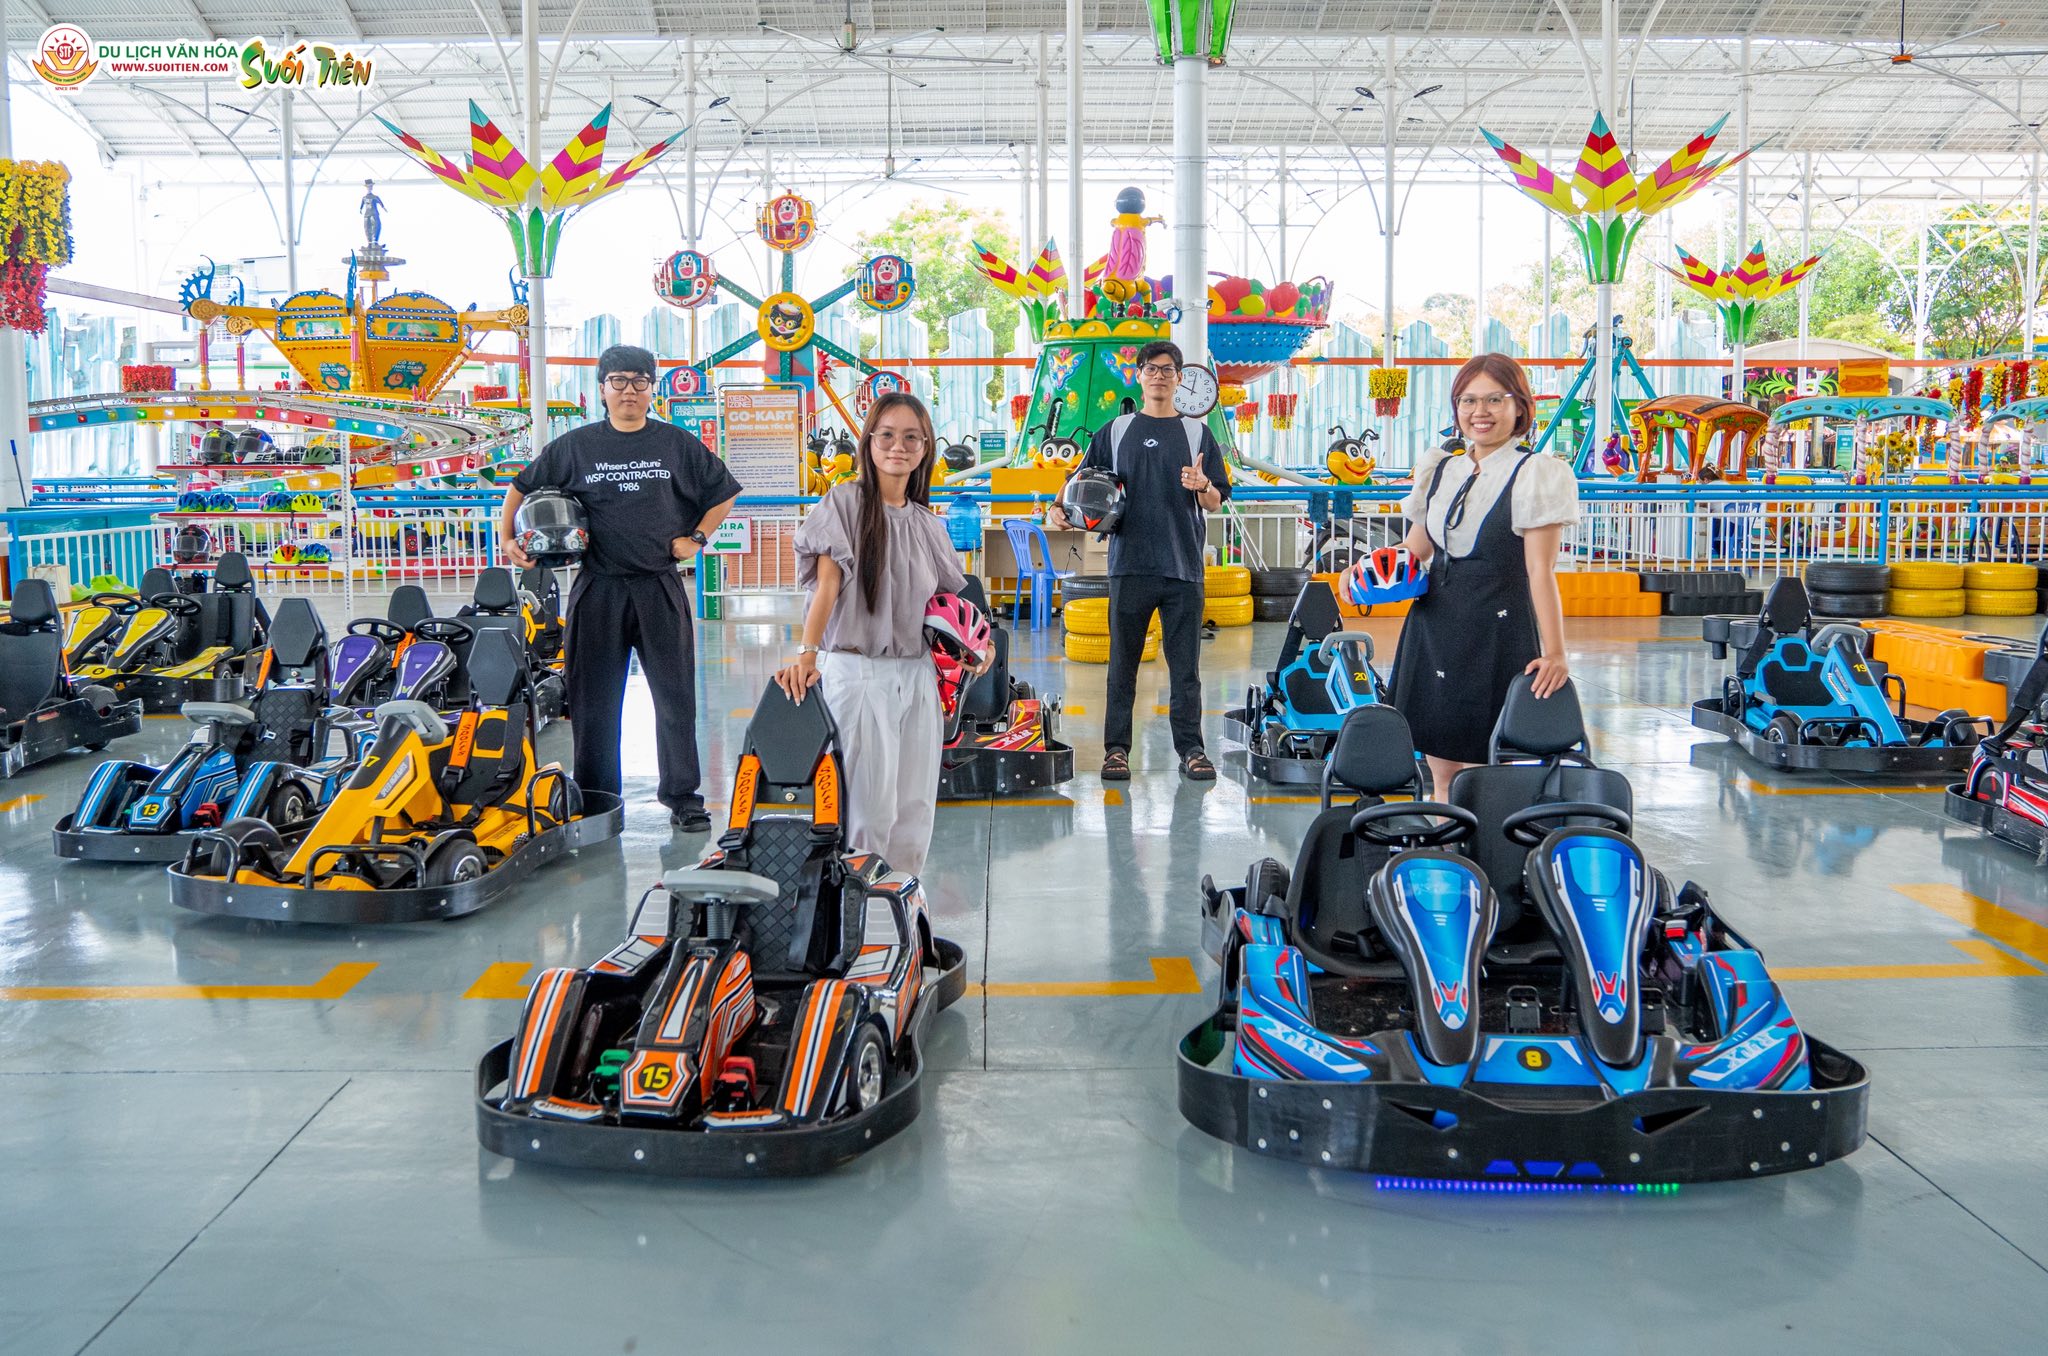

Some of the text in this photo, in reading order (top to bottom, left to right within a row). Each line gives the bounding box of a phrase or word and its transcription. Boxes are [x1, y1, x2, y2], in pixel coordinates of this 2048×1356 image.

[728, 410, 794, 422] GO-KART
[595, 462, 628, 471] Whsers
[585, 469, 671, 484] WSP CONTRACTED
[618, 482, 640, 492] 1986
[730, 522, 744, 530] RA
[1853, 663, 1867, 672] 19
[1353, 671, 1368, 681] 20
[143, 803, 160, 816] 13
[1525, 1050, 1543, 1068] 8
[643, 1066, 671, 1089] 15
